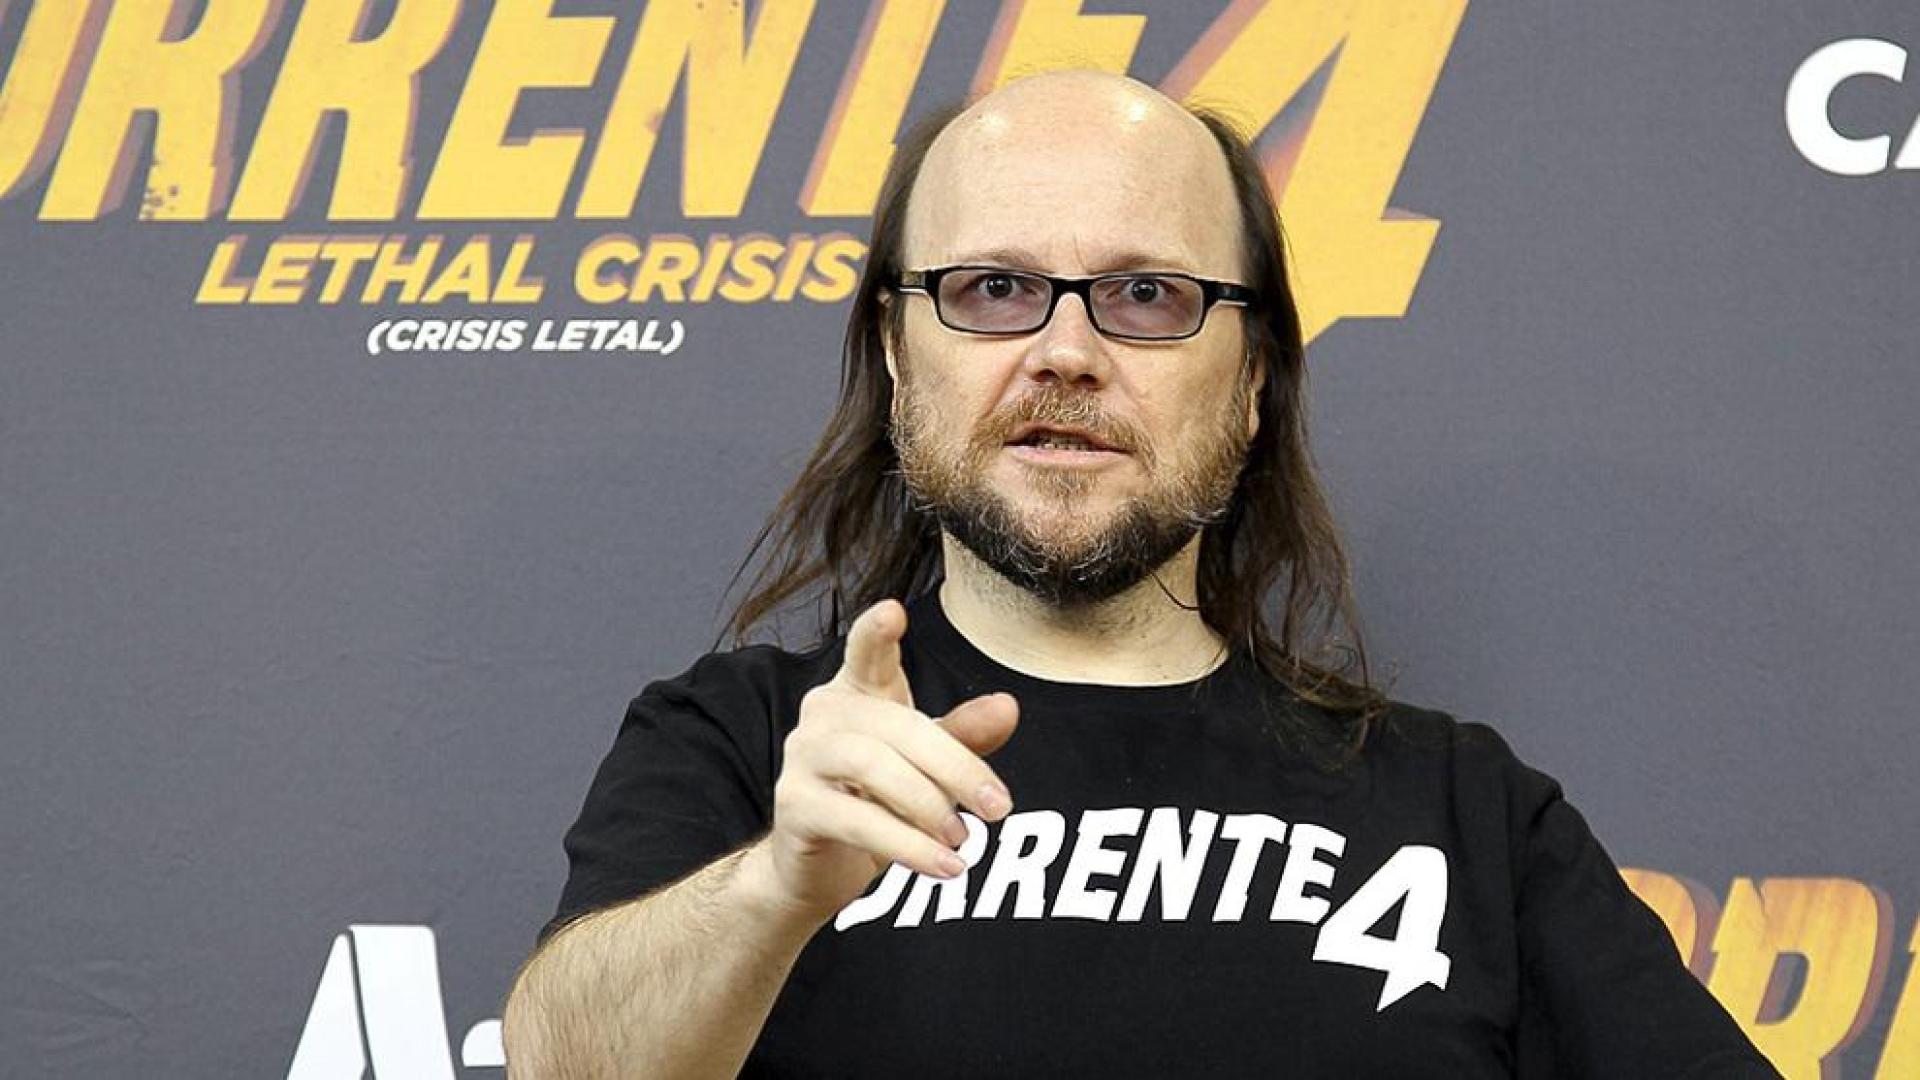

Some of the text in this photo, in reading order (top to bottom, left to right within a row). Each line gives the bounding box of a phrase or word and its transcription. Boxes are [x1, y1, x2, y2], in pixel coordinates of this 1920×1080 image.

[1785, 37, 1920, 176] C
[195, 234, 870, 304] LETHAL CRISIS
[367, 319, 685, 356] (CRISIS LETAL)
